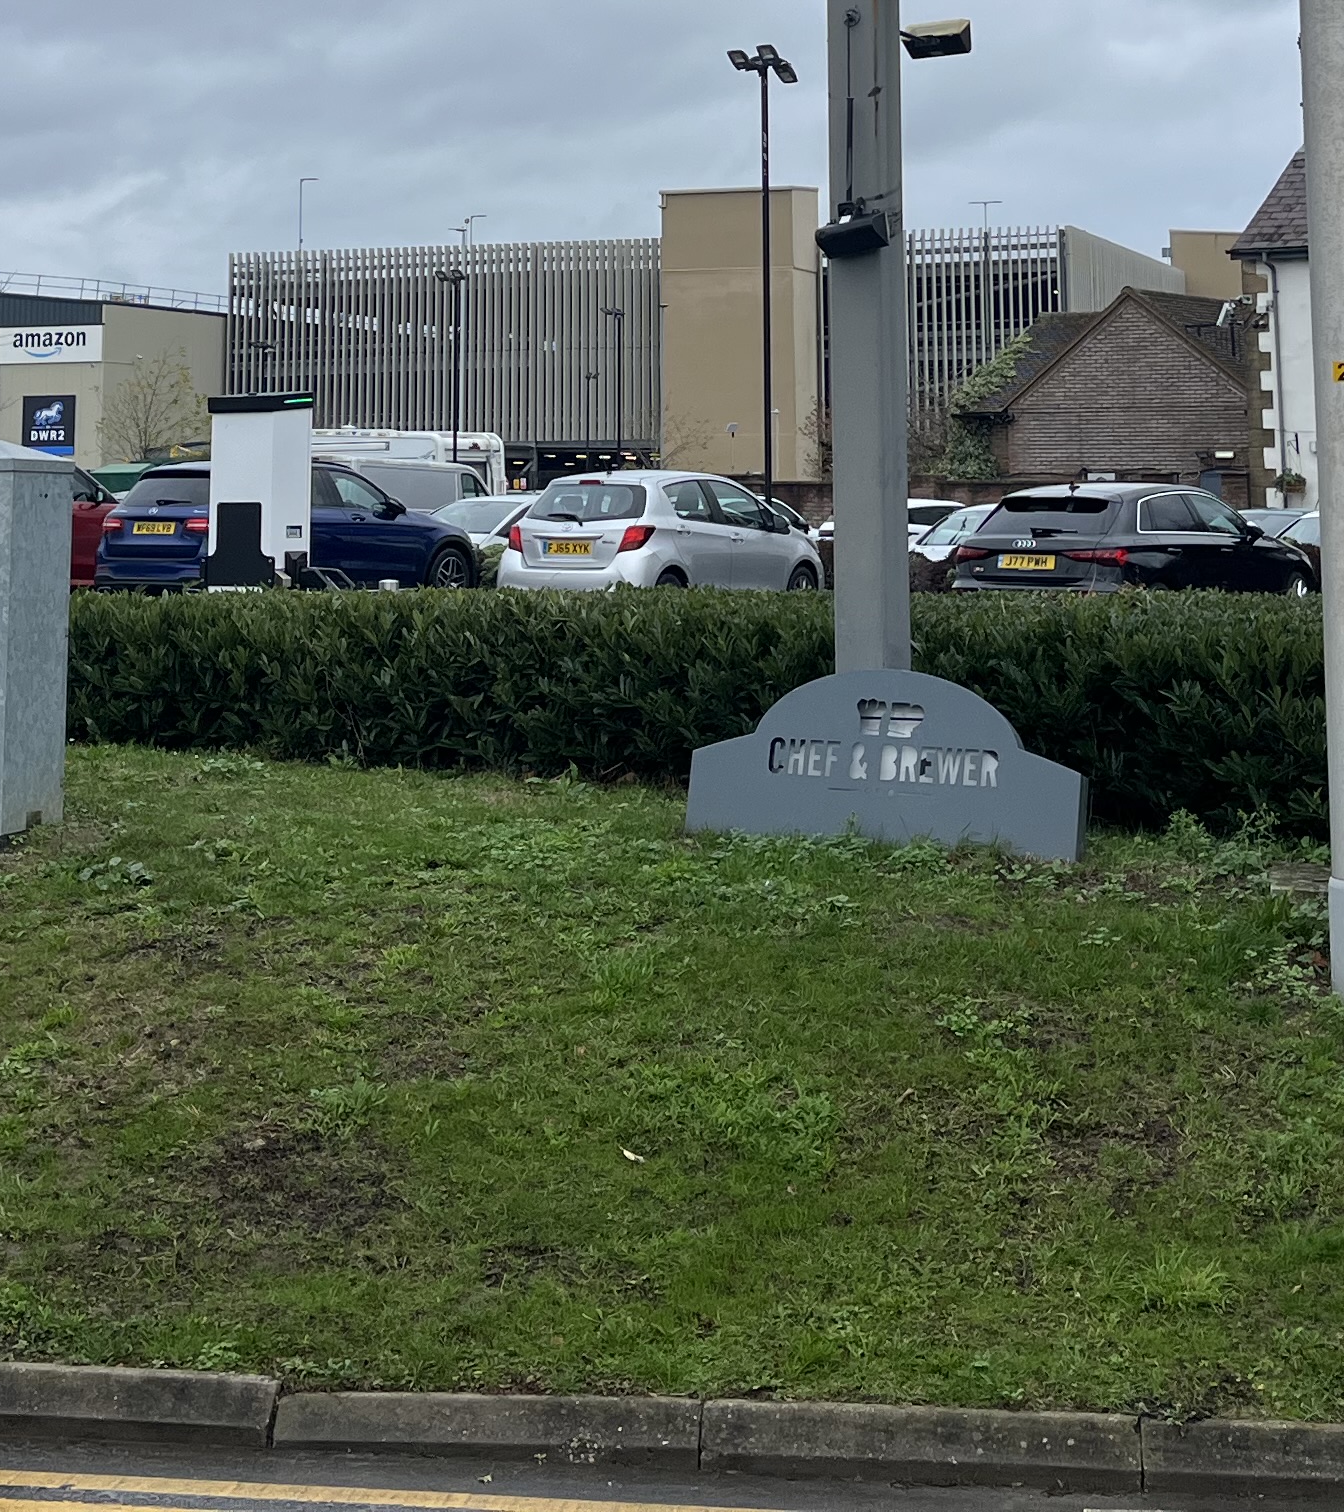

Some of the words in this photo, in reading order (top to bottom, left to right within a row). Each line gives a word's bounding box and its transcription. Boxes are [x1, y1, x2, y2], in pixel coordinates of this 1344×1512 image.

[13, 331, 87, 348] amazon
[30, 430, 65, 442] DWR2
[572, 543, 590, 554] XYK
[1005, 556, 1025, 566] J77
[768, 737, 841, 777] CHEF
[849, 743, 868, 780] &
[879, 744, 1000, 788] BREWER
